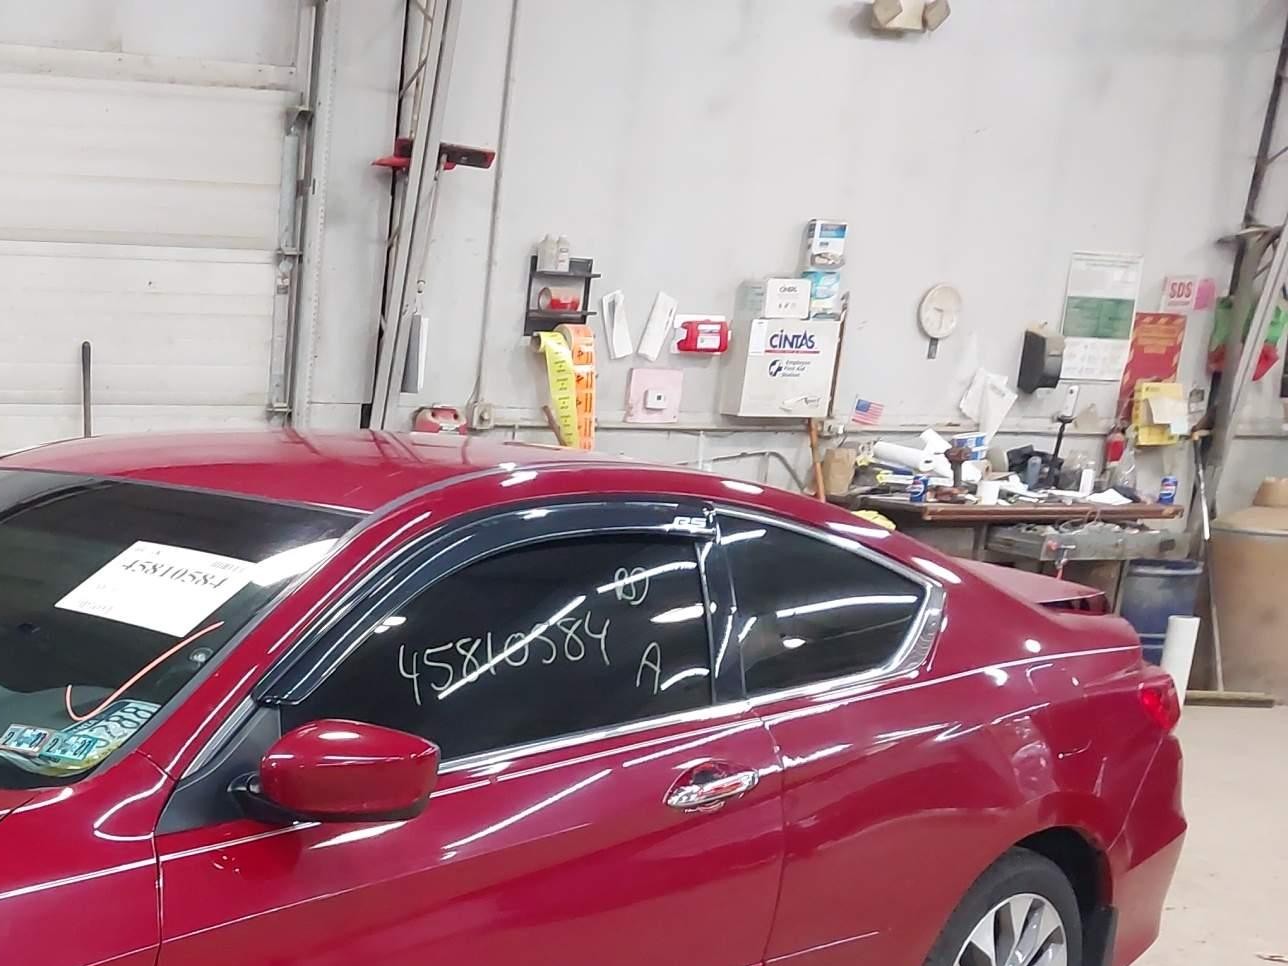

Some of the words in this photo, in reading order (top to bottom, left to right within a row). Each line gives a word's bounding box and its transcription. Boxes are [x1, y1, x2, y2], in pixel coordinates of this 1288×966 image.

[1169, 281, 1193, 299] SDS
[122, 559, 228, 589] 45810584
[398, 611, 611, 705] 45810584
[636, 642, 662, 695] A
